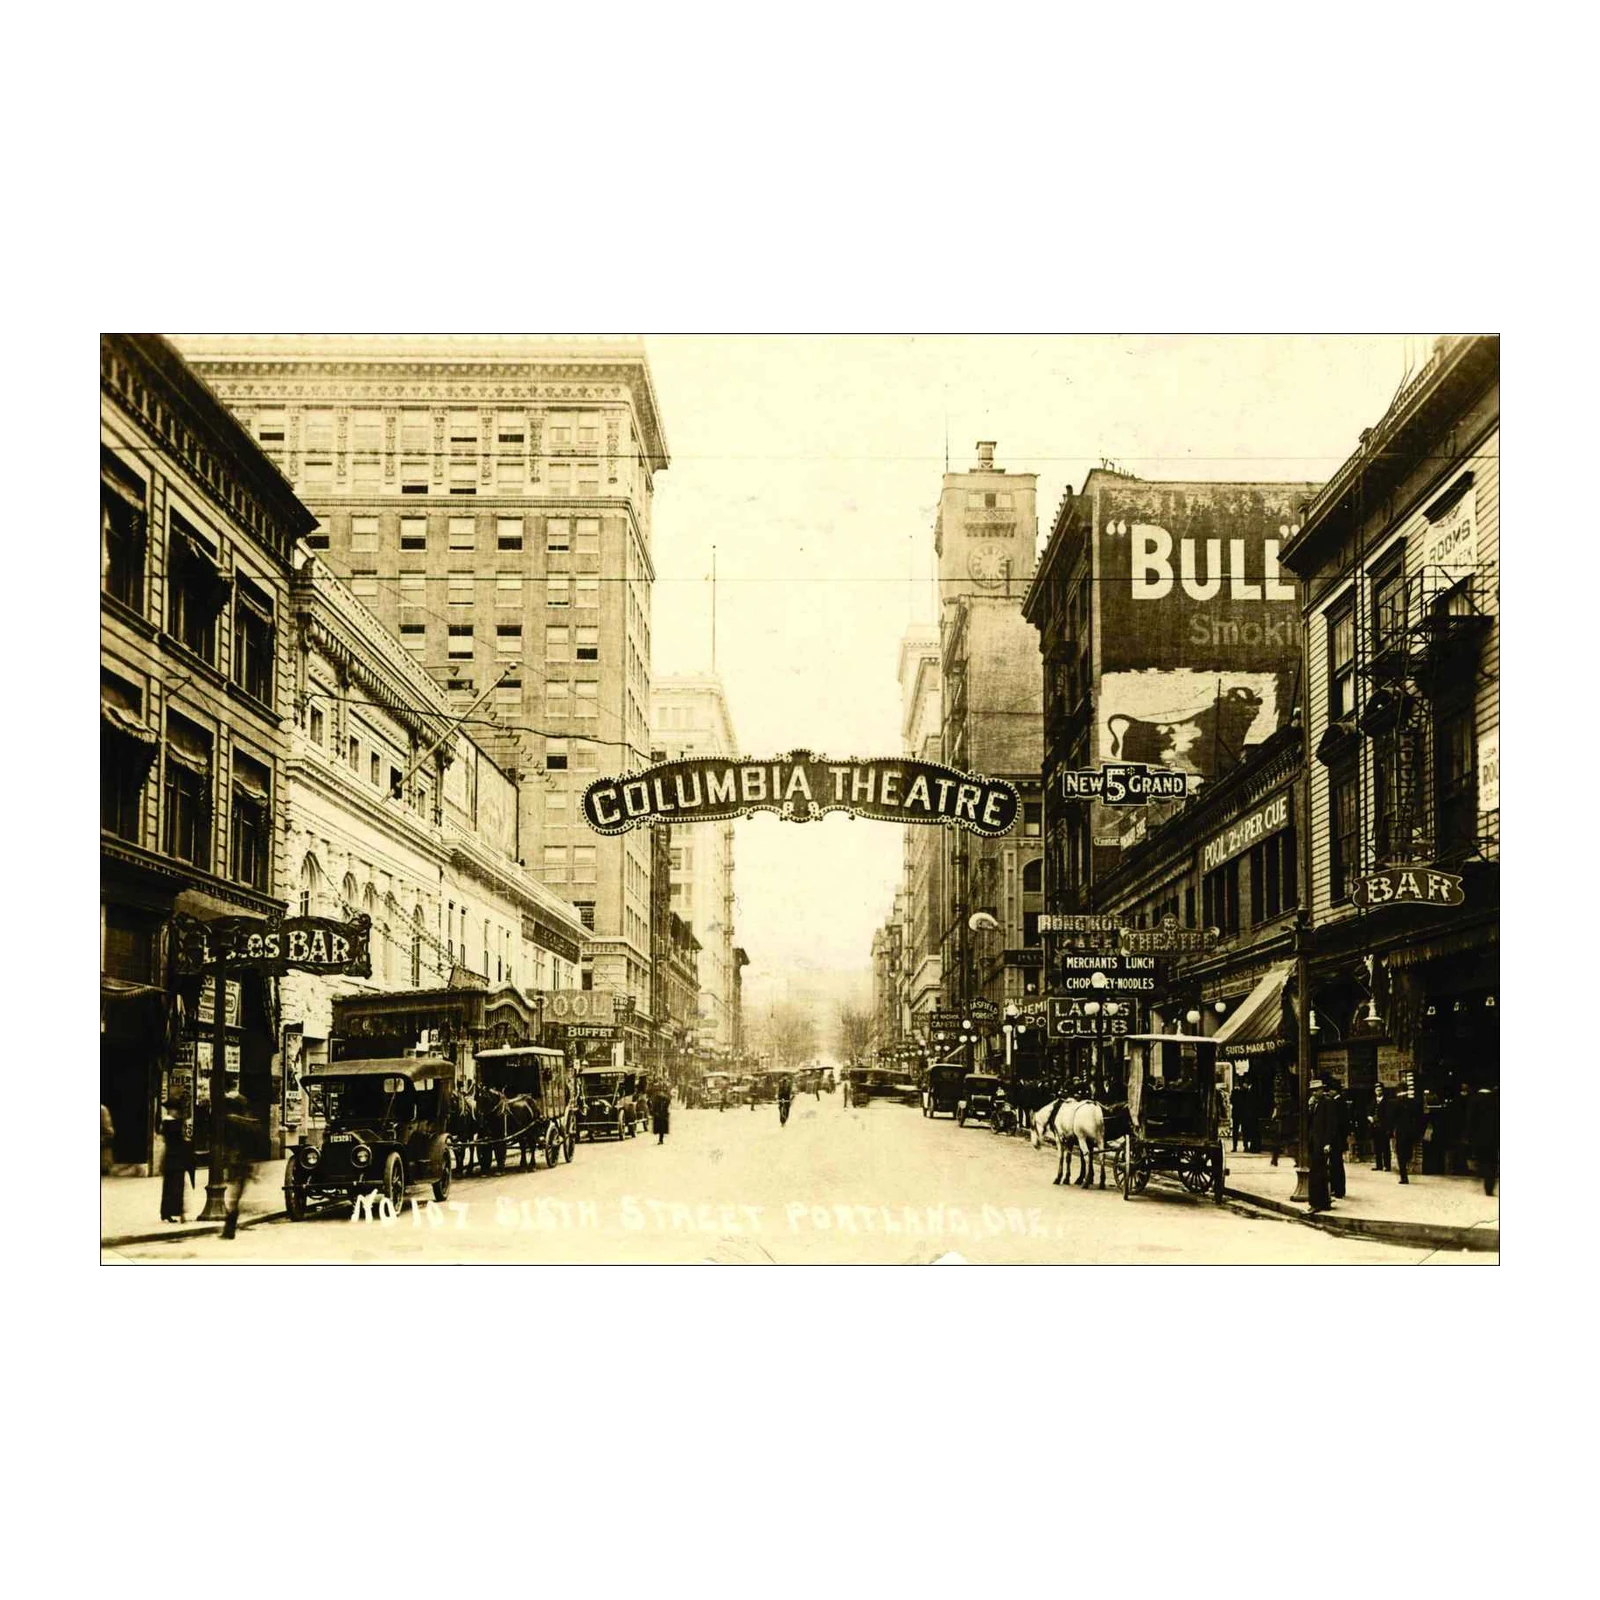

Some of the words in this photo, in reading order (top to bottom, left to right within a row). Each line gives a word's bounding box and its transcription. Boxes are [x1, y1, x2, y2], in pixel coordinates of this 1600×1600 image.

[1190, 611, 1301, 646] Smoki
[1066, 774, 1104, 793] NEW
[1128, 775, 1184, 793] GRAND
[592, 766, 812, 825] COLUMBIA
[829, 766, 1008, 826] THEATRE
[1204, 833, 1227, 872] POOL
[1245, 813, 1263, 843] PER
[1265, 796, 1287, 829] CUE
[1366, 872, 1453, 903] BAR
[286, 929, 351, 963] BAR
[1066, 957, 1118, 969] MERCHANTS
[1126, 957, 1155, 969] LUNCH
[1066, 977, 1091, 989] CHOP
[534, 995, 606, 1017] POOL
[567, 1026, 614, 1037] BUFFET
[1057, 1019, 1128, 1034] CLUB
[1225, 1044, 1245, 1055] SUITS
[1246, 1042, 1266, 1054] MADE
[1266, 1040, 1275, 1051] TO
